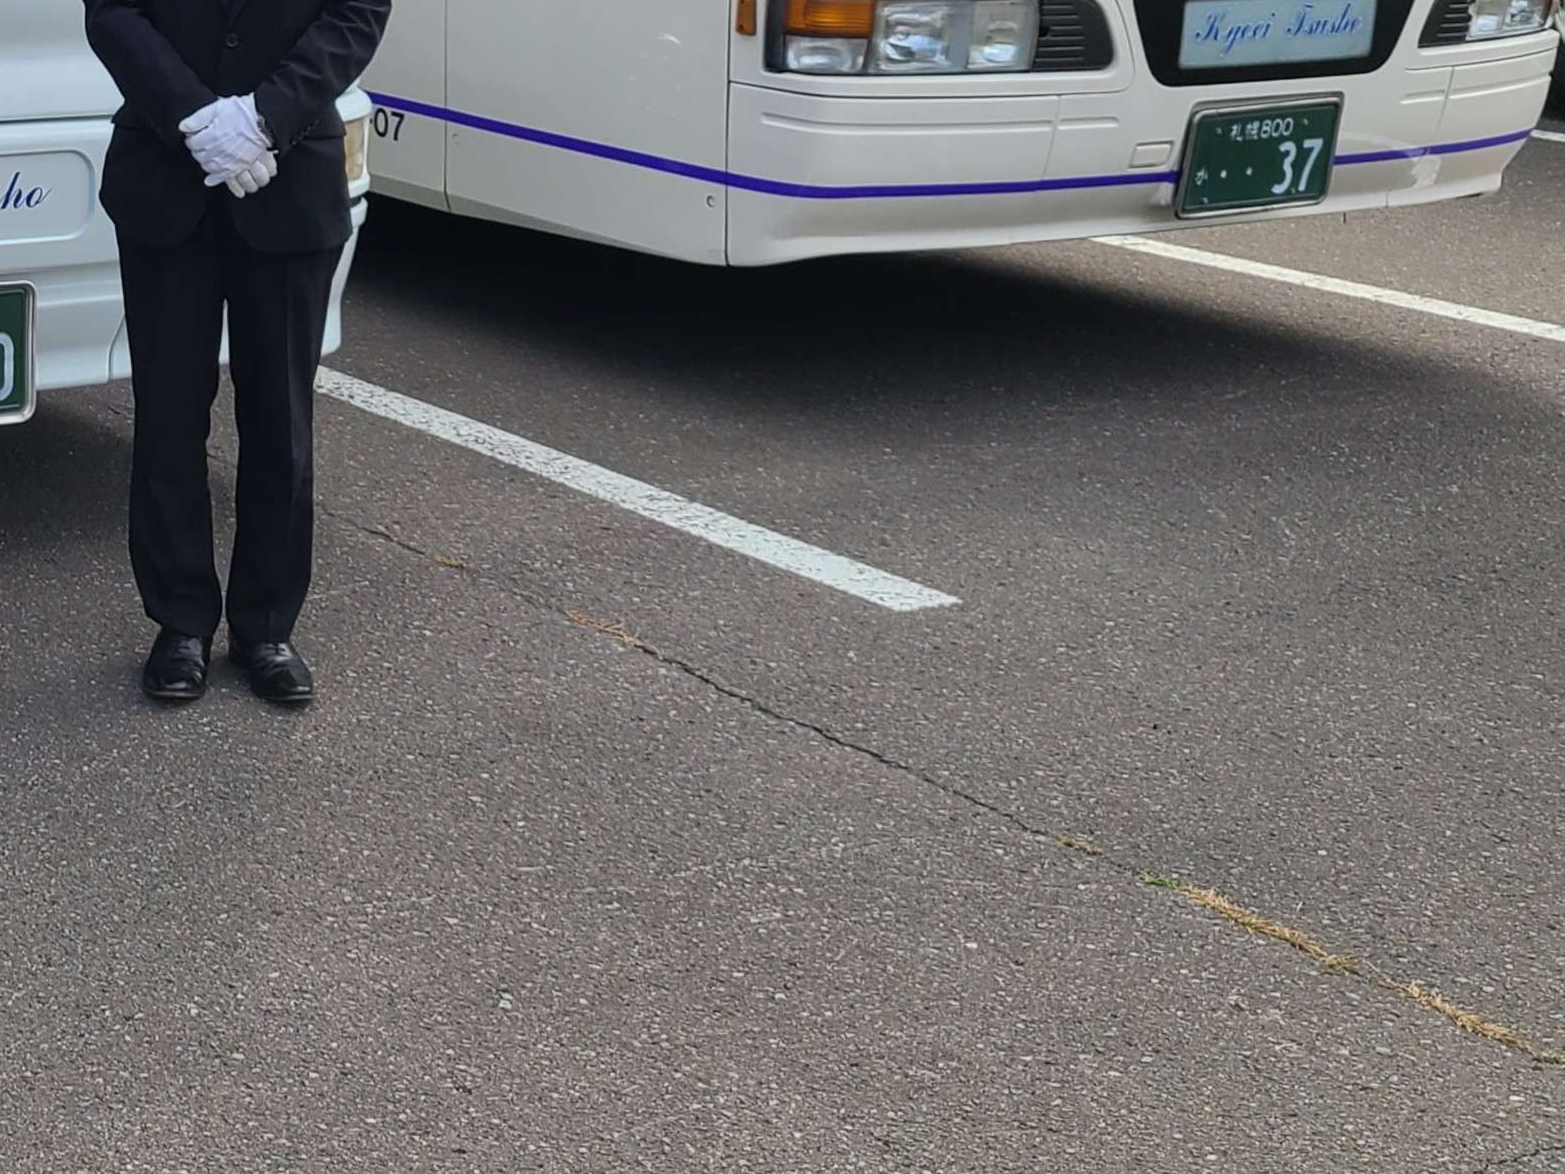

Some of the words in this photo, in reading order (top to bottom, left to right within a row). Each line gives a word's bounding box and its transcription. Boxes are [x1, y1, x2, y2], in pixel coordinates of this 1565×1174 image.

[1195, 11, 1276, 57] Kyoei
[1287, 2, 1362, 37] Tsusho
[1271, 137, 1324, 195] 37
